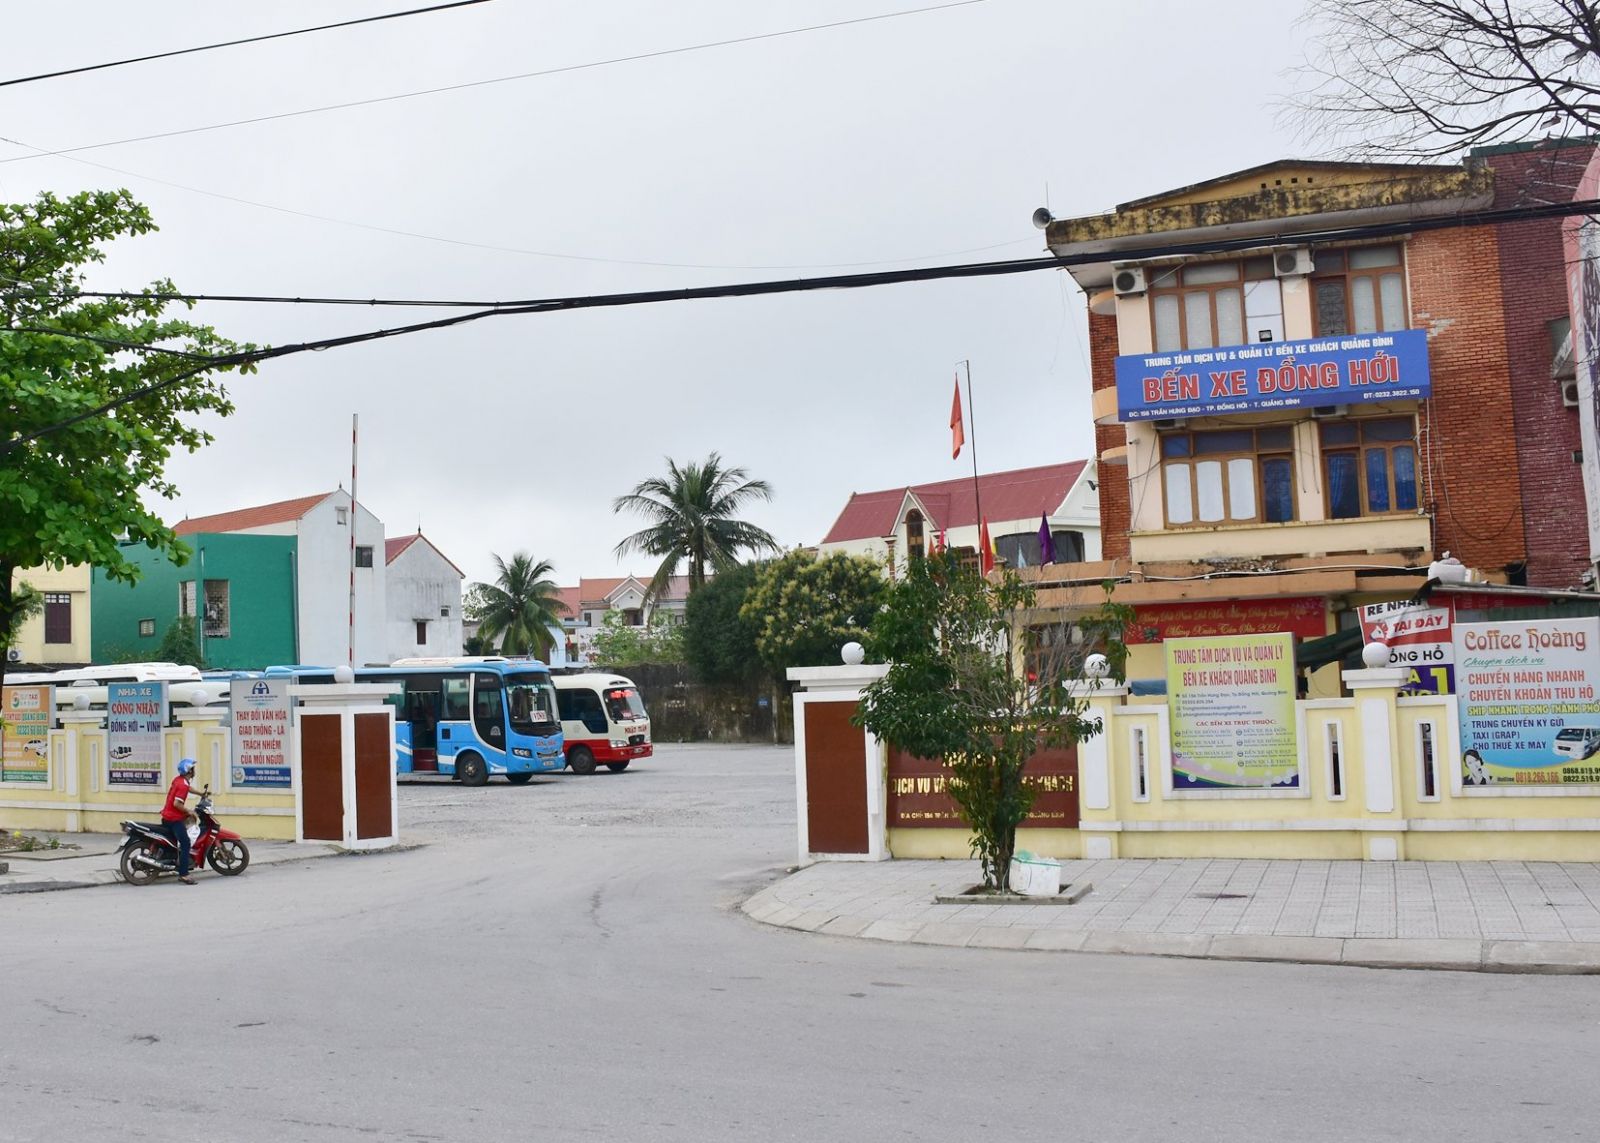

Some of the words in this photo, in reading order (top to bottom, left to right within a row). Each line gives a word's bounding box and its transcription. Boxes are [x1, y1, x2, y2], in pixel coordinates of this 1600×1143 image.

[1144, 358, 1171, 368] TRUNG
[1173, 354, 1191, 365] TÂM
[1194, 353, 1213, 365] DỊCH
[1216, 352, 1227, 363] VỤ
[1229, 351, 1236, 360] &
[1238, 347, 1262, 359] QUẢN
[1264, 346, 1273, 357] LÝ
[1276, 345, 1293, 356] BẾN
[1295, 345, 1306, 354] XE
[1309, 340, 1338, 353] KHÁCH
[1341, 337, 1370, 351] QUẢNG
[1373, 336, 1393, 347] BÌNH
[1143, 367, 1199, 403] BẾN
[1209, 369, 1248, 397] XE
[1257, 356, 1339, 394] ĐỒNG
[1348, 350, 1399, 386] HỚI
[1151, 407, 1168, 416] TRẦN
[1188, 406, 1200, 414] ĐẠO
[1393, 620, 1411, 634] TẠI
[1415, 615, 1443, 629] ĐÂY
[1464, 630, 1521, 651] Coffee
[1173, 649, 1196, 664] TRUNG
[1198, 645, 1213, 663] TÂM
[1214, 648, 1231, 666] DỊCH
[1232, 647, 1242, 665] VỤ
[1243, 644, 1253, 661] VÀ
[1254, 641, 1274, 662] QUẢN
[1275, 641, 1283, 659] LÝ
[1183, 667, 1197, 686] BẾN
[1198, 671, 1208, 686] XE
[1209, 667, 1232, 686] KHÁCH
[1234, 665, 1258, 687] QUẢNG
[1259, 665, 1277, 683] BÌNH
[1468, 668, 1510, 685] CHUYỂN
[1513, 668, 1543, 683] HÀNG
[1546, 670, 1585, 682] NHANH
[140, 687, 152, 696] XE
[1469, 684, 1511, 702] CHUYỂN
[1514, 684, 1552, 701] KHOẢN
[1554, 686, 1575, 699] THU
[1578, 684, 1594, 701] HỘ
[111, 700, 134, 714] CÔNG
[136, 700, 160, 717] NHẬT
[236, 710, 250, 720] THAY
[251, 707, 261, 720] ĐỔI
[262, 708, 274, 720] VĂN
[1468, 705, 1486, 716] SHIP
[1488, 704, 1518, 715] NHANH
[1520, 704, 1549, 714] TRONG
[1551, 701, 1579, 714] THÀNH
[147, 720, 161, 733] VINH
[239, 725, 252, 735] GIAO
[253, 723, 272, 735] THÔNG
[1471, 720, 1499, 729] TRUNG
[1501, 716, 1535, 728] CHUYỂN
[1472, 731, 1490, 740] TAXI
[243, 738, 260, 750] TRÁCH
[262, 738, 281, 752] NHIỆM
[1473, 742, 1490, 751] CHO
[1492, 740, 1512, 750] THUÊ
[1515, 741, 1526, 749] XE
[241, 752, 252, 764] CỦA
[917, 778, 930, 797] VỤ
[933, 774, 945, 793] VÀ
